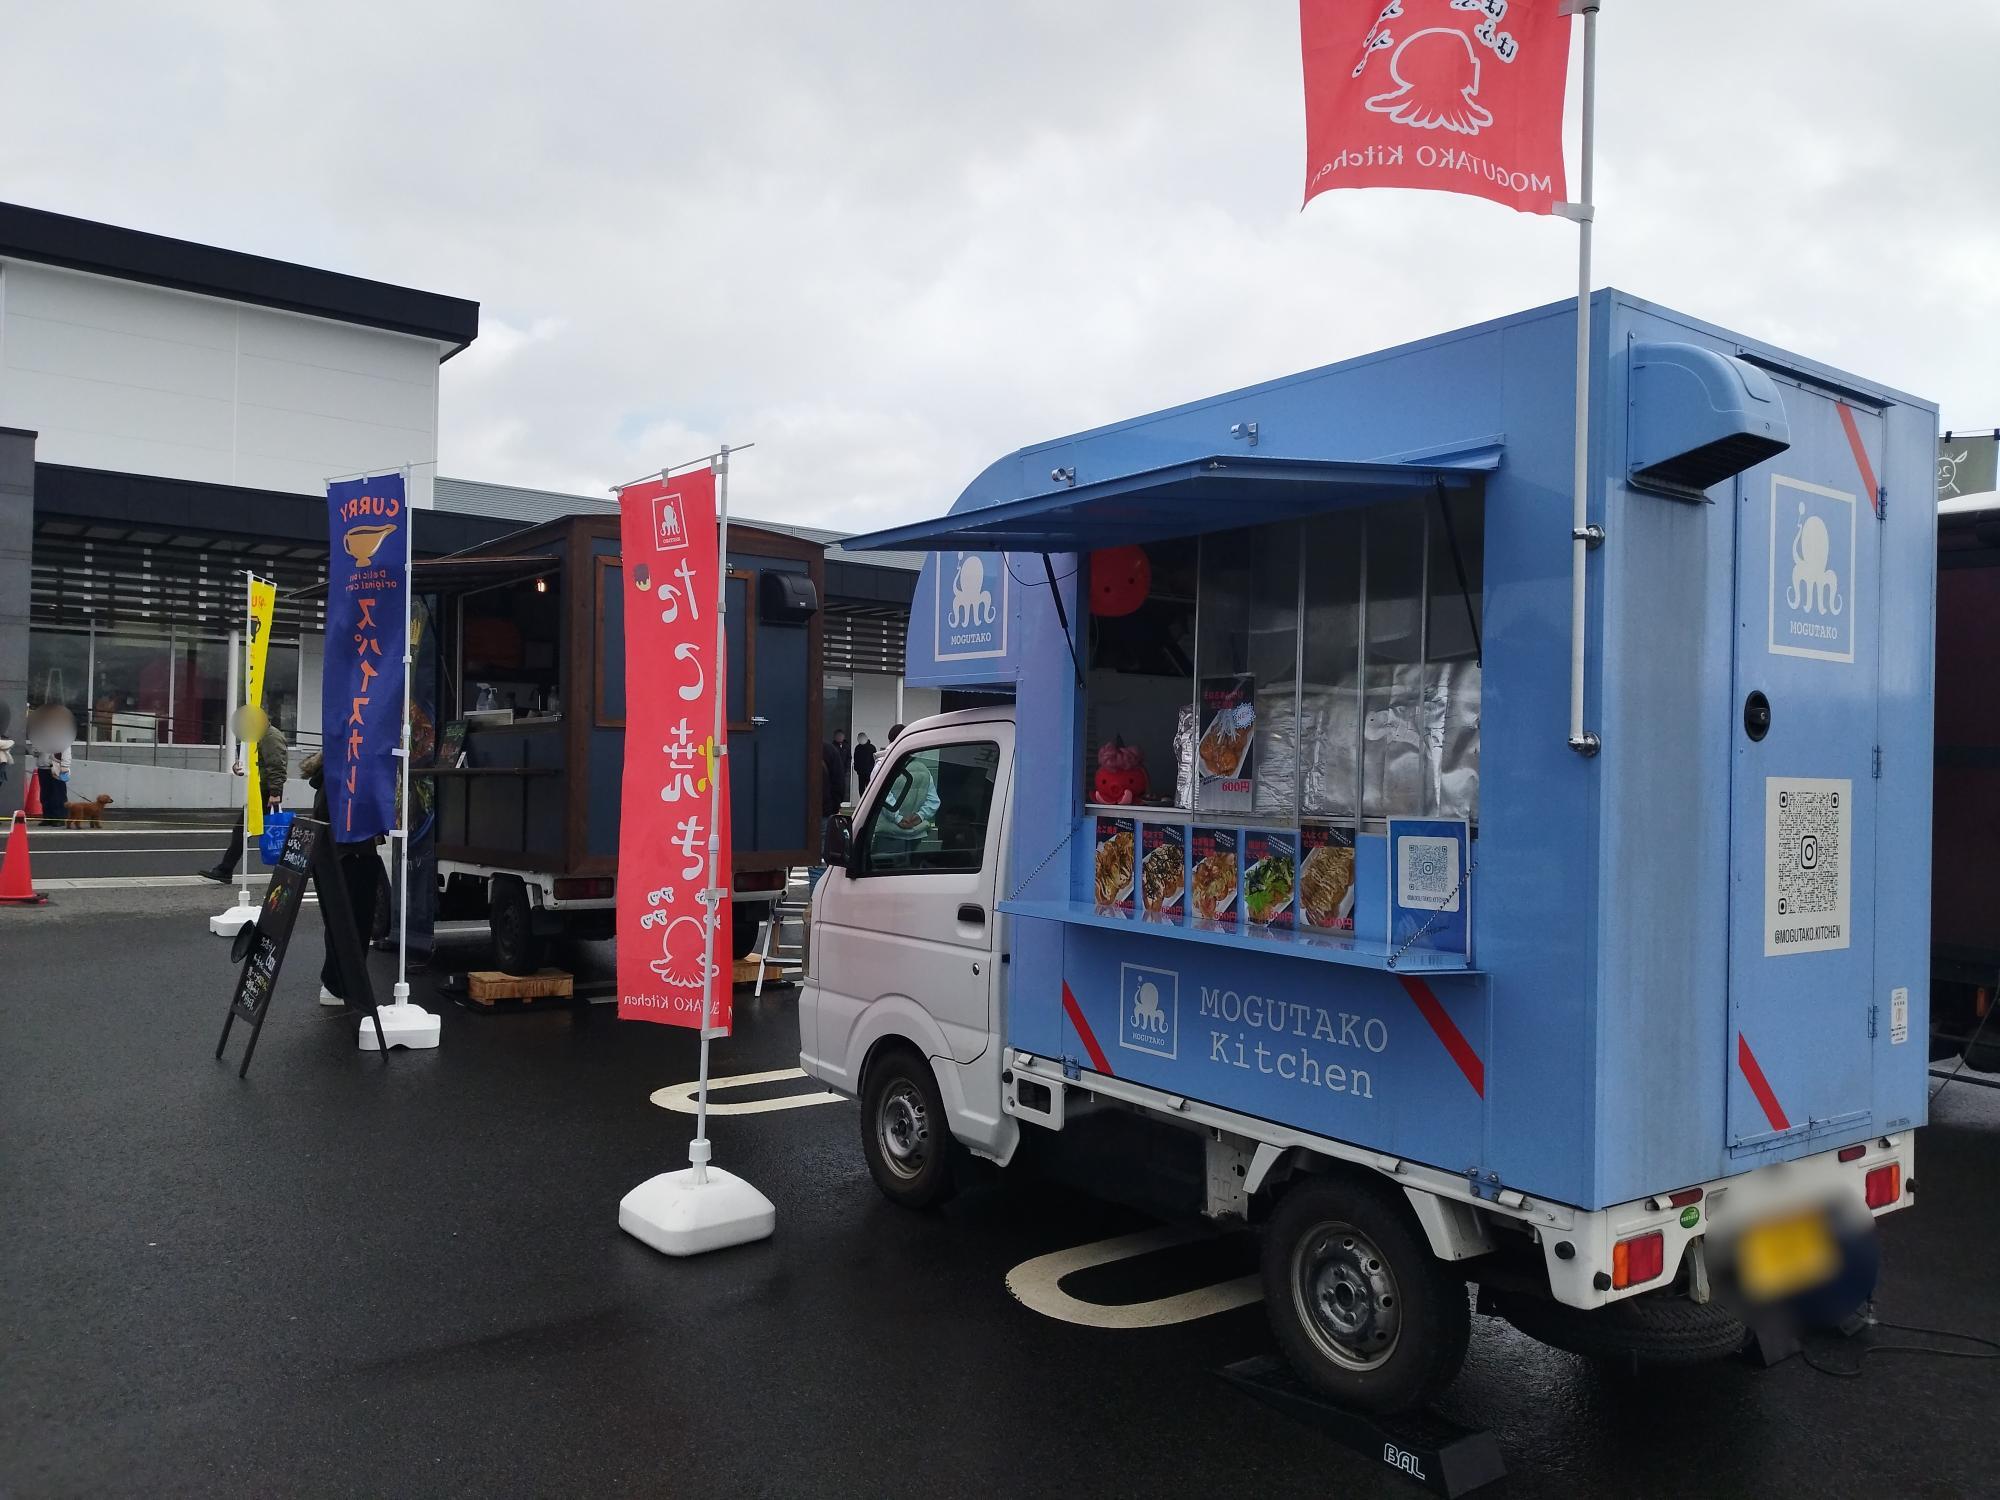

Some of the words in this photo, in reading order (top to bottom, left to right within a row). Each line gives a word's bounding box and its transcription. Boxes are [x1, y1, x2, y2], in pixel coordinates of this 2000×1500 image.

[951, 632, 992, 645] MOGUTAKO
[1790, 620, 1838, 640] MOGUTAKO
[1222, 781, 1250, 793] 600円
[1774, 924, 1841, 944] @MOGUTAKO.KITCHEN
[1200, 986, 1388, 1053] MOGUTAKO
[1132, 1032, 1165, 1046] MOGUTAKO
[1210, 1031, 1373, 1099] Kitchen
[1383, 1443, 1425, 1480] BAL
